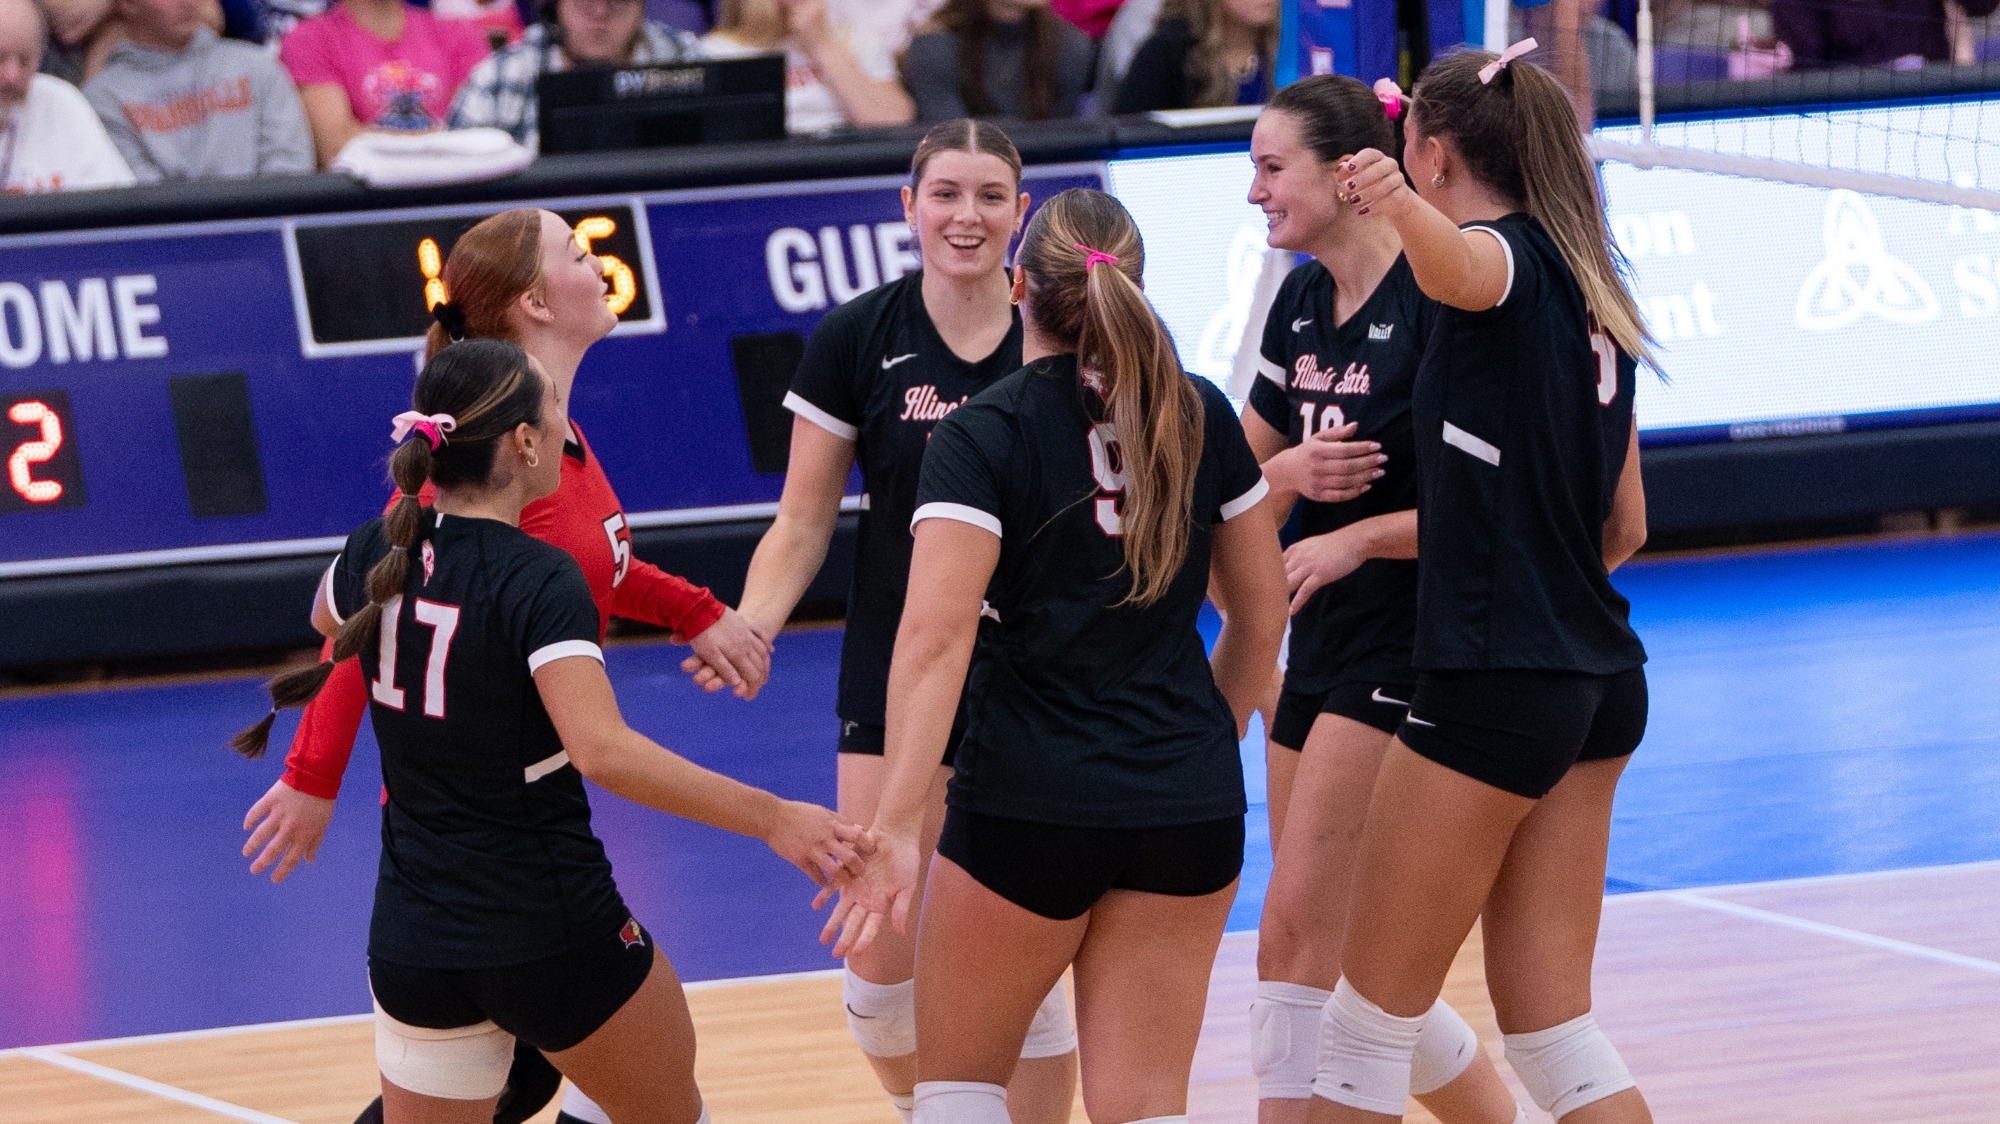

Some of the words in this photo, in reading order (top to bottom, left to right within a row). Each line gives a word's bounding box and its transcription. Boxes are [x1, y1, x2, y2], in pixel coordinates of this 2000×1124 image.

[765, 221, 923, 315] GUE
[0, 273, 170, 369] OME
[7, 400, 63, 503] 2
[1086, 421, 1140, 538] 9
[602, 510, 631, 589] 5
[371, 593, 461, 720] 17
